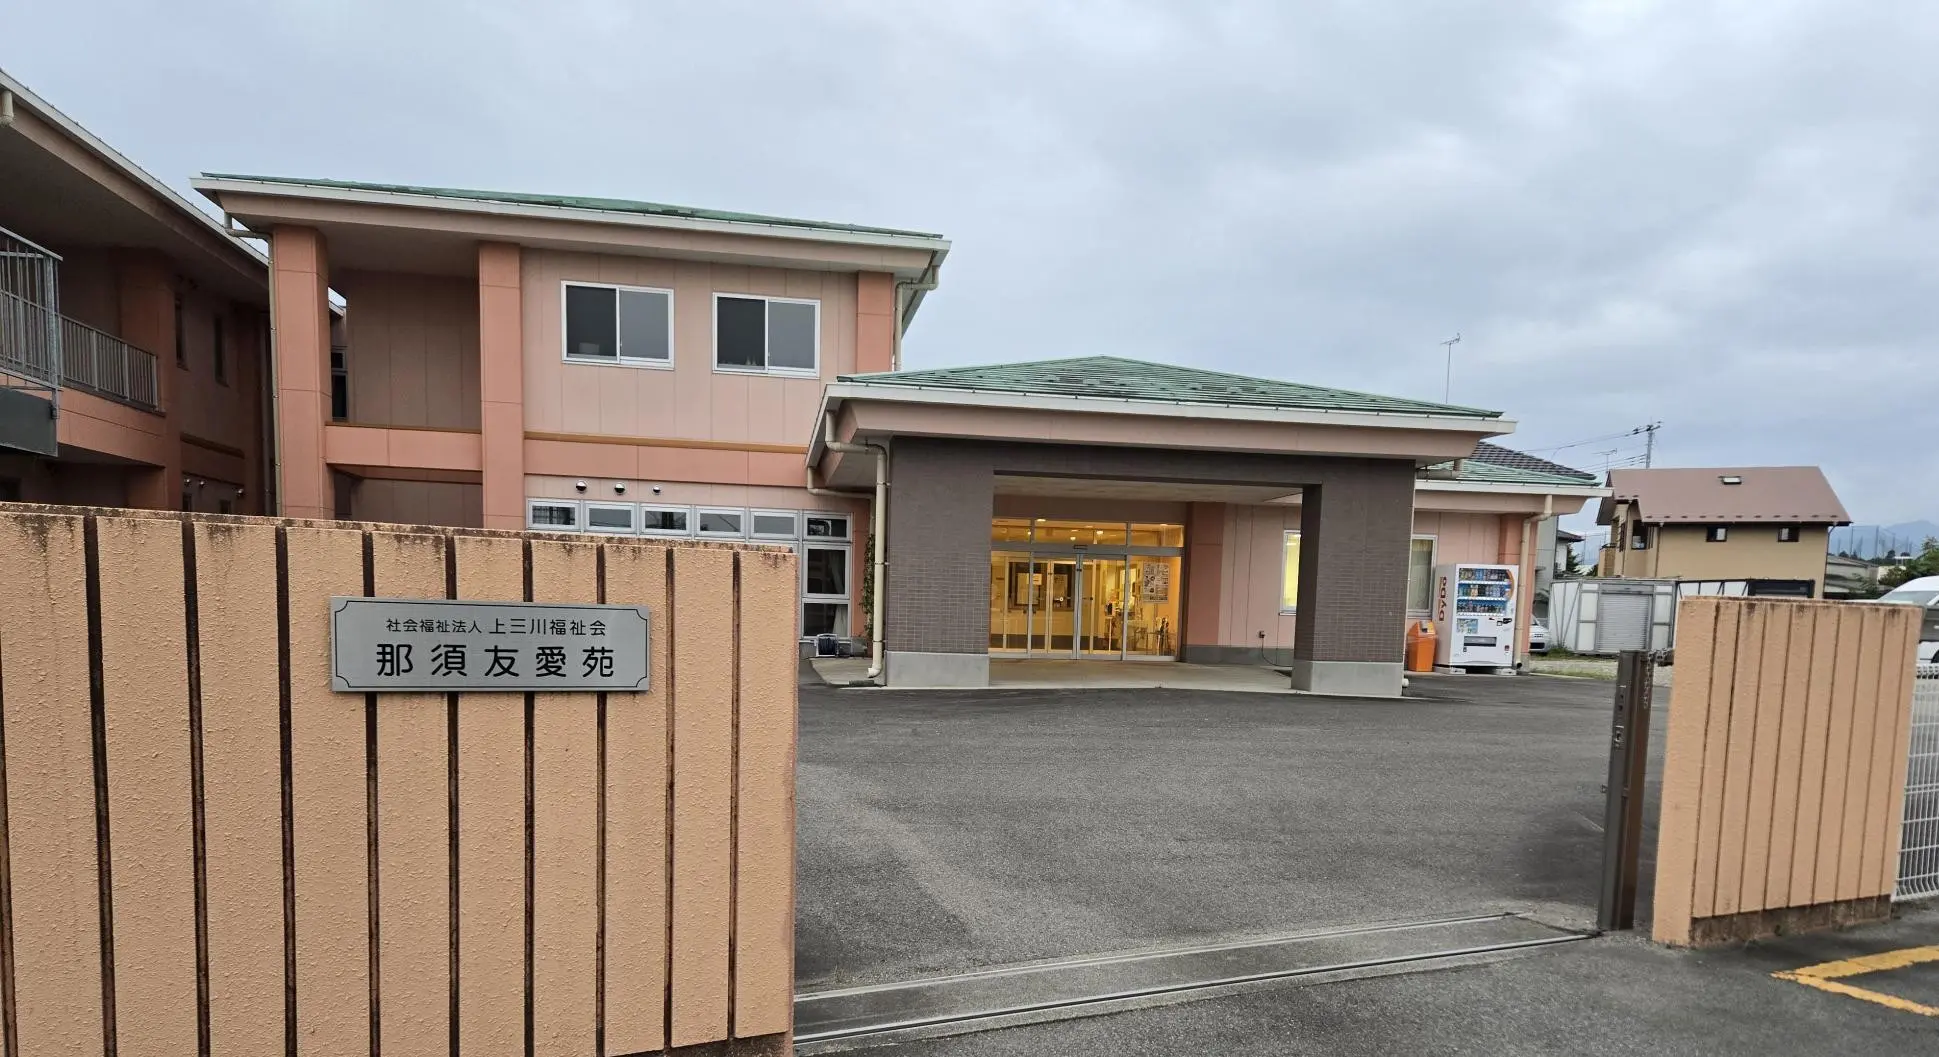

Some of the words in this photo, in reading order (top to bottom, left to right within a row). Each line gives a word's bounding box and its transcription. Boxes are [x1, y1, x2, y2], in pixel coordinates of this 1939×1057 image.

[385, 618, 482, 634] 社会福祉法人
[488, 617, 606, 637] 上三川福祉会
[375, 643, 615, 678] 那須友愛苑
